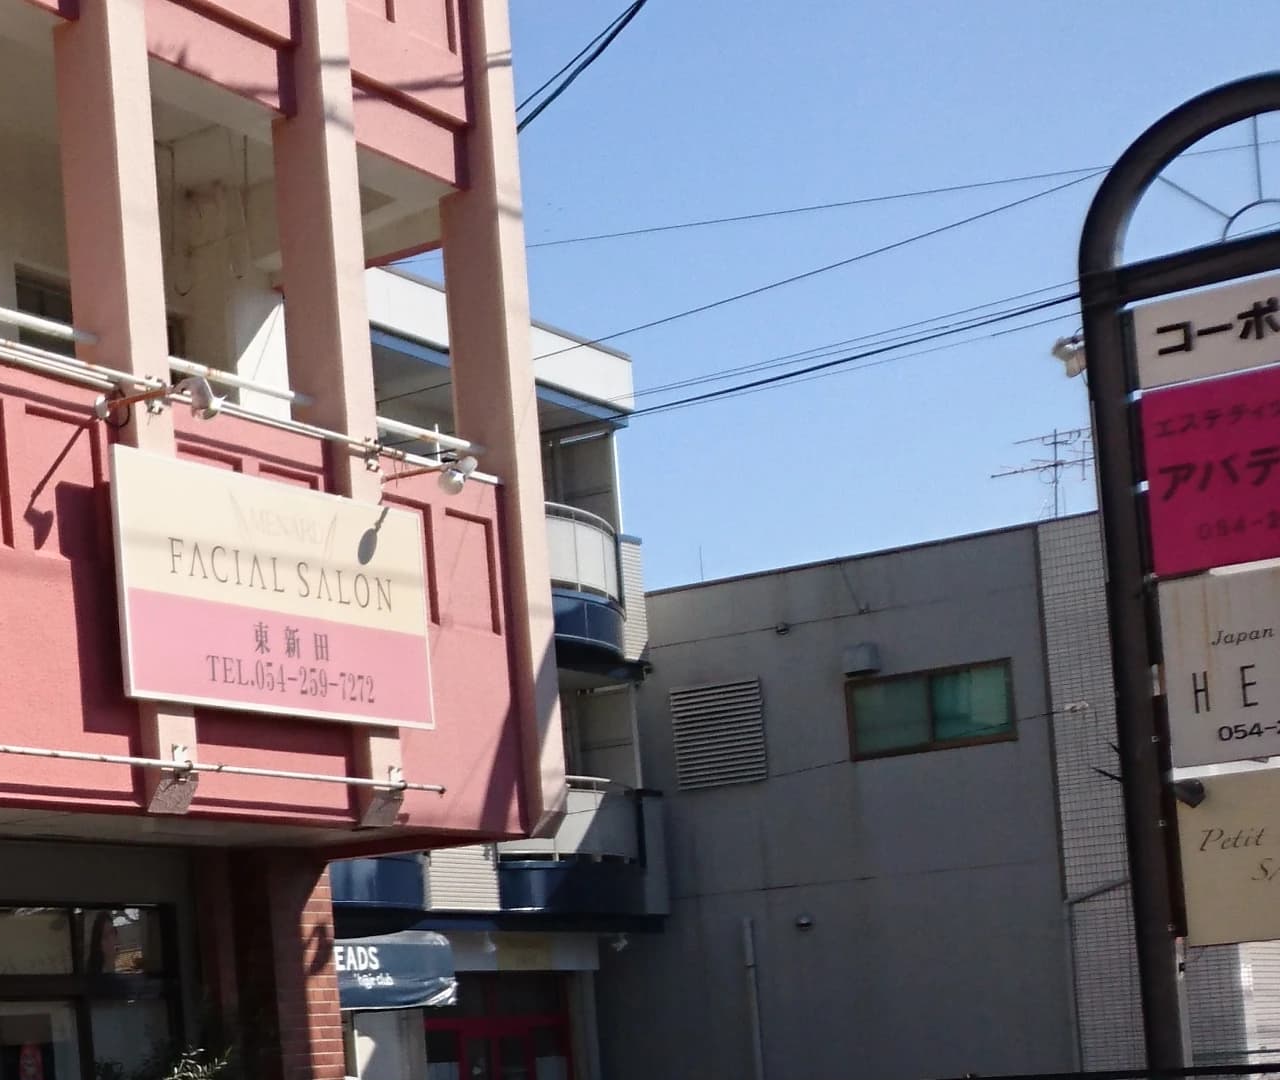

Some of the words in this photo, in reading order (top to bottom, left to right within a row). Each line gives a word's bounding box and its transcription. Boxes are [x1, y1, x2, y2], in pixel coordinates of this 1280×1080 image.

[167, 536, 286, 594] FACIAL
[296, 560, 394, 613] SALON
[252, 621, 330, 663] 東新田
[1211, 626, 1274, 647] Japan
[206, 654, 376, 704] TEL.054-259-7272
[1218, 722, 1280, 743] 054-
[1200, 827, 1267, 852] Petit
